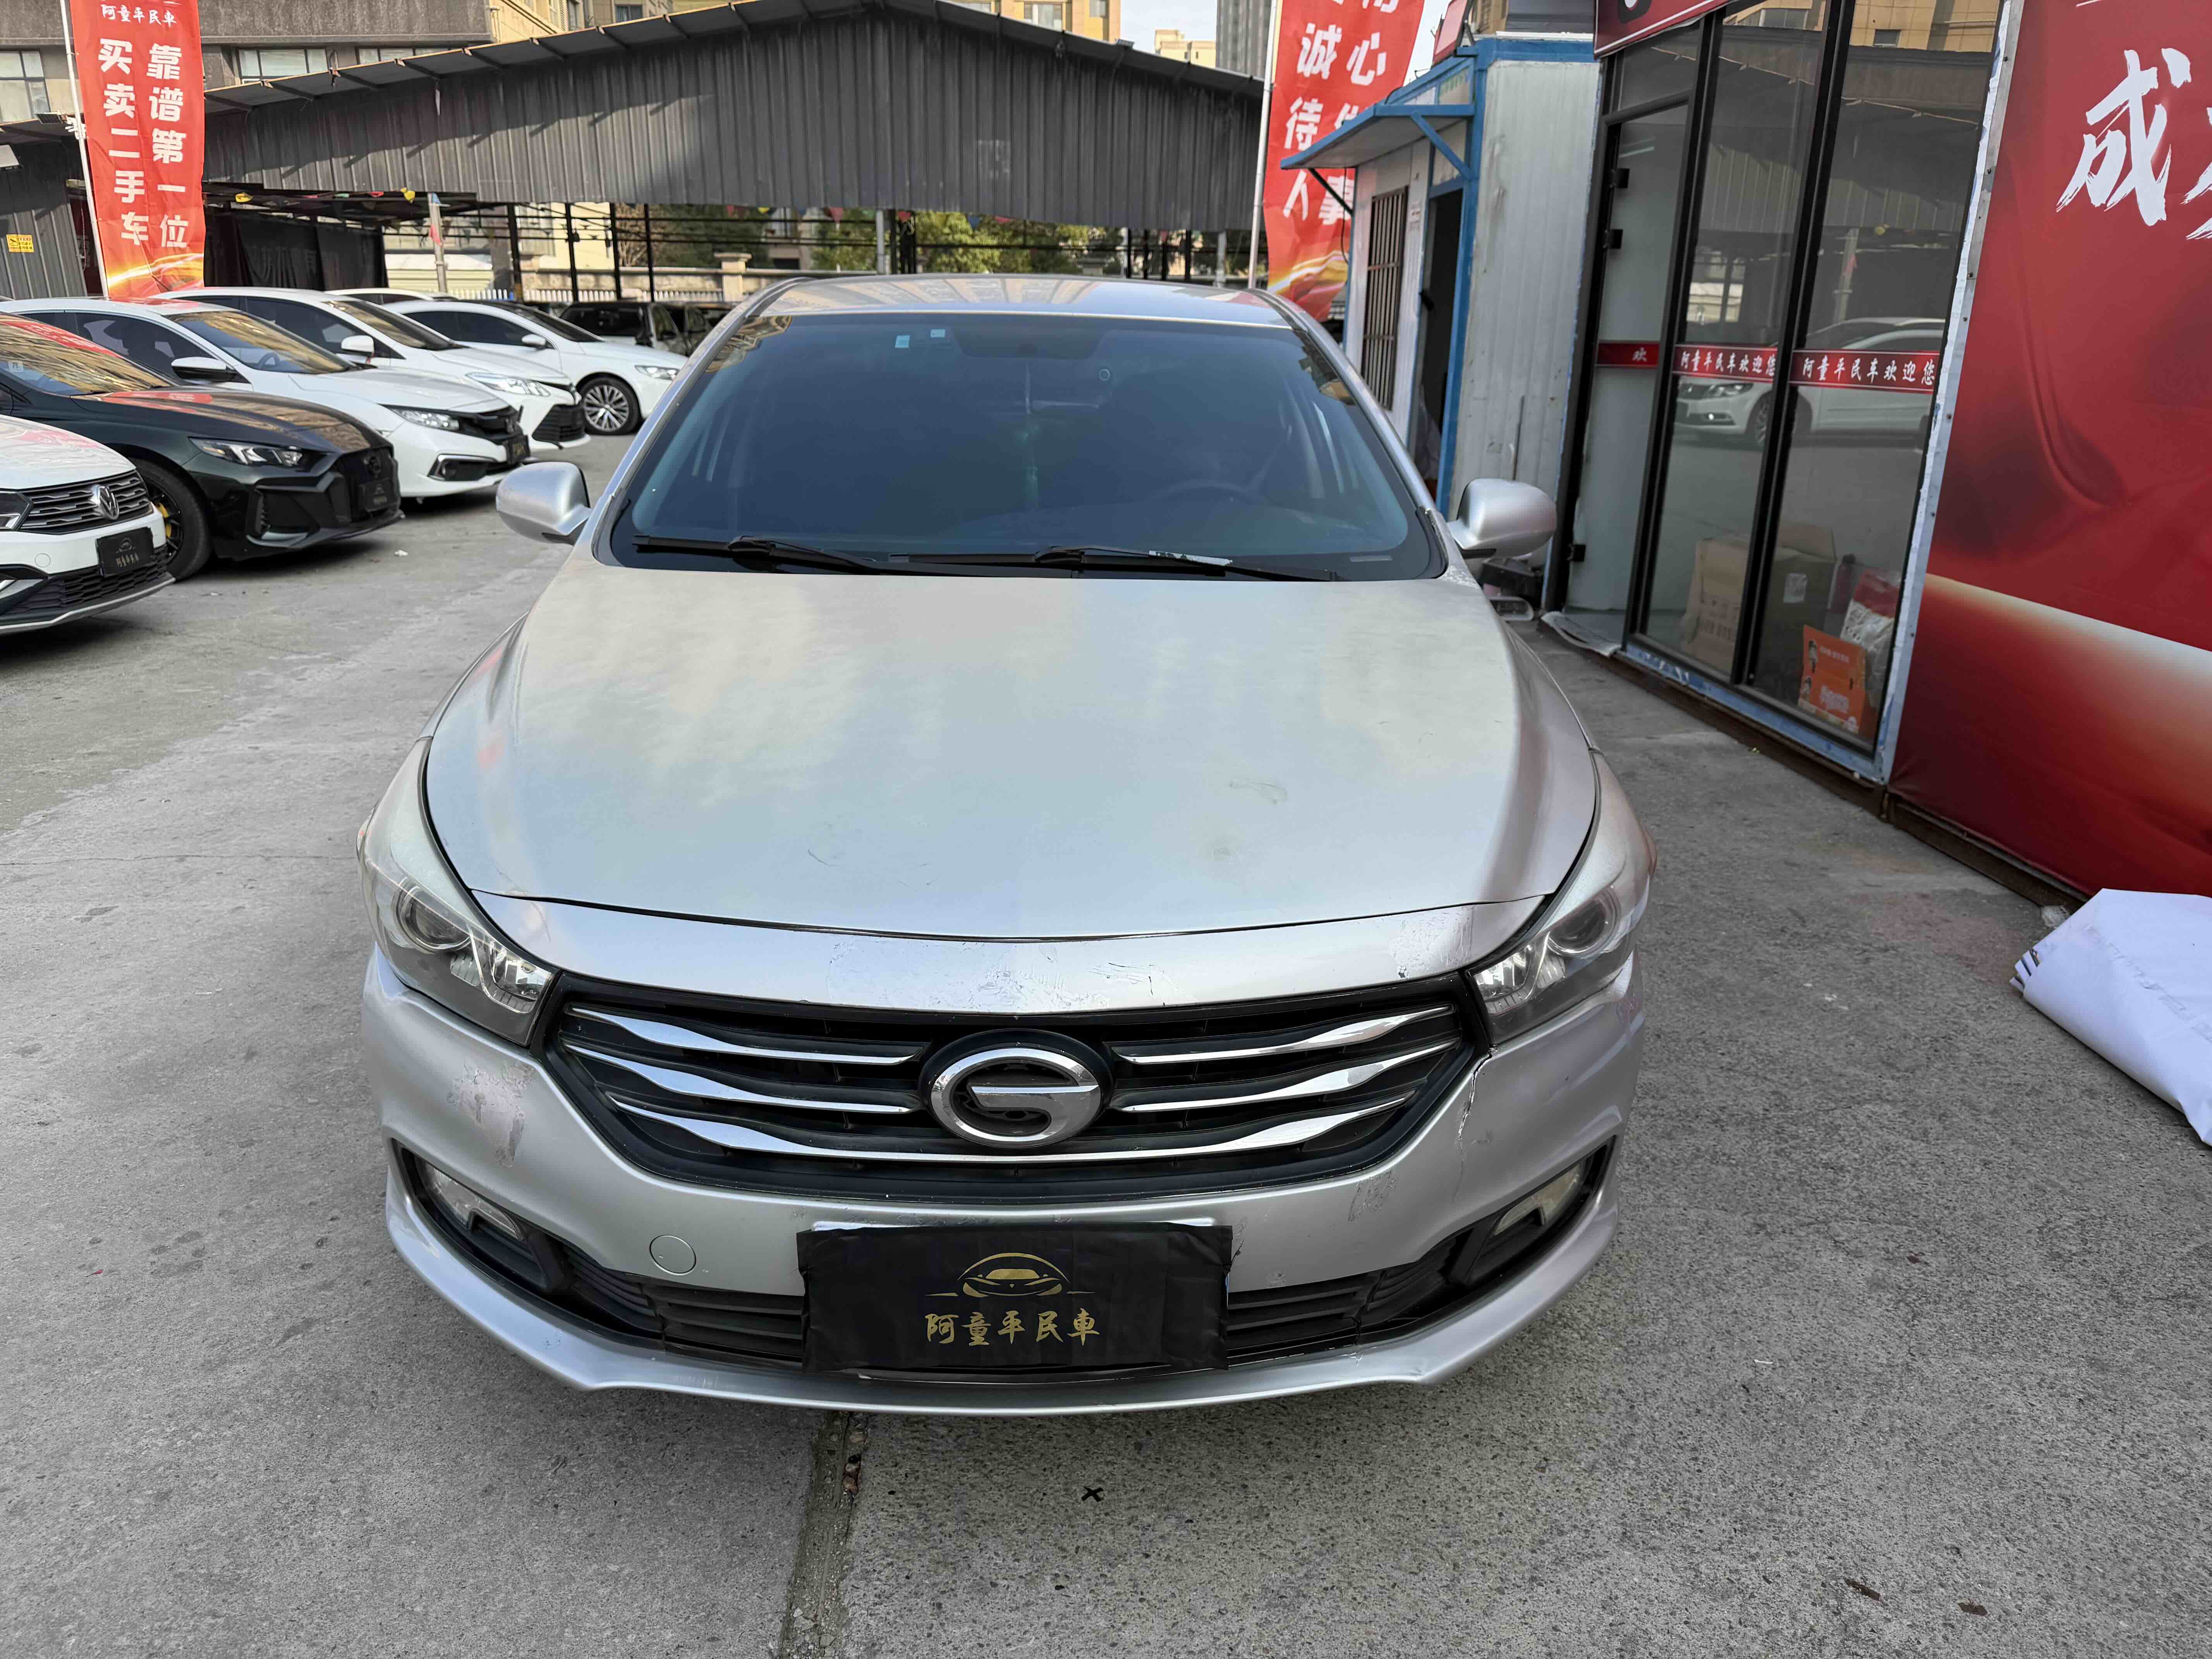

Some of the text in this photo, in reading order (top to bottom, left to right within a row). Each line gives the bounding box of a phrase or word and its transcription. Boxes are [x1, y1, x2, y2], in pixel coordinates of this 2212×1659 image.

[98, 38, 149, 245] 买卖二手车
[146, 43, 189, 248] 靠谱第一位
[1283, 0, 1344, 221] 诚待人
[2056, 47, 2212, 240] 成
[924, 1307, 1100, 1346] 阿童平民車
